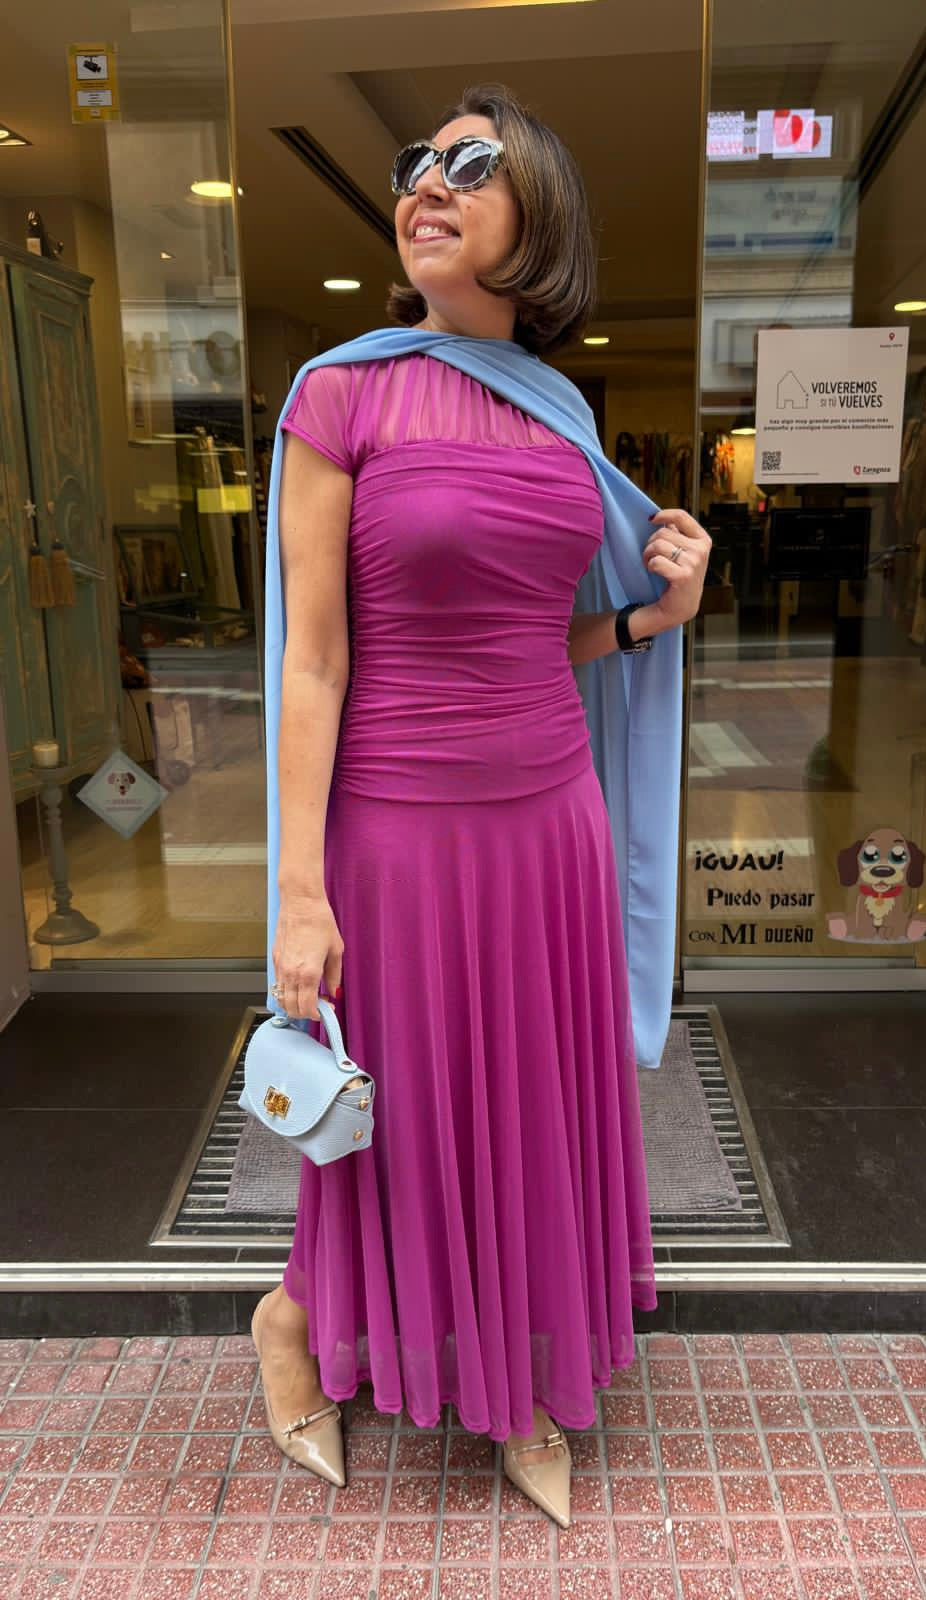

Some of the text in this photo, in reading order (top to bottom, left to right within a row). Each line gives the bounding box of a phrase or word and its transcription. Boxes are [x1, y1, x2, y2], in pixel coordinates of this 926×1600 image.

[811, 381, 877, 394] VOLVEREMOS
[839, 394, 883, 408] VUELVES
[695, 850, 784, 871] ¡GUAU!
[707, 888, 815, 910] Puedo pasar
[720, 923, 757, 945] MI
[764, 925, 814, 943] DUEÑO
